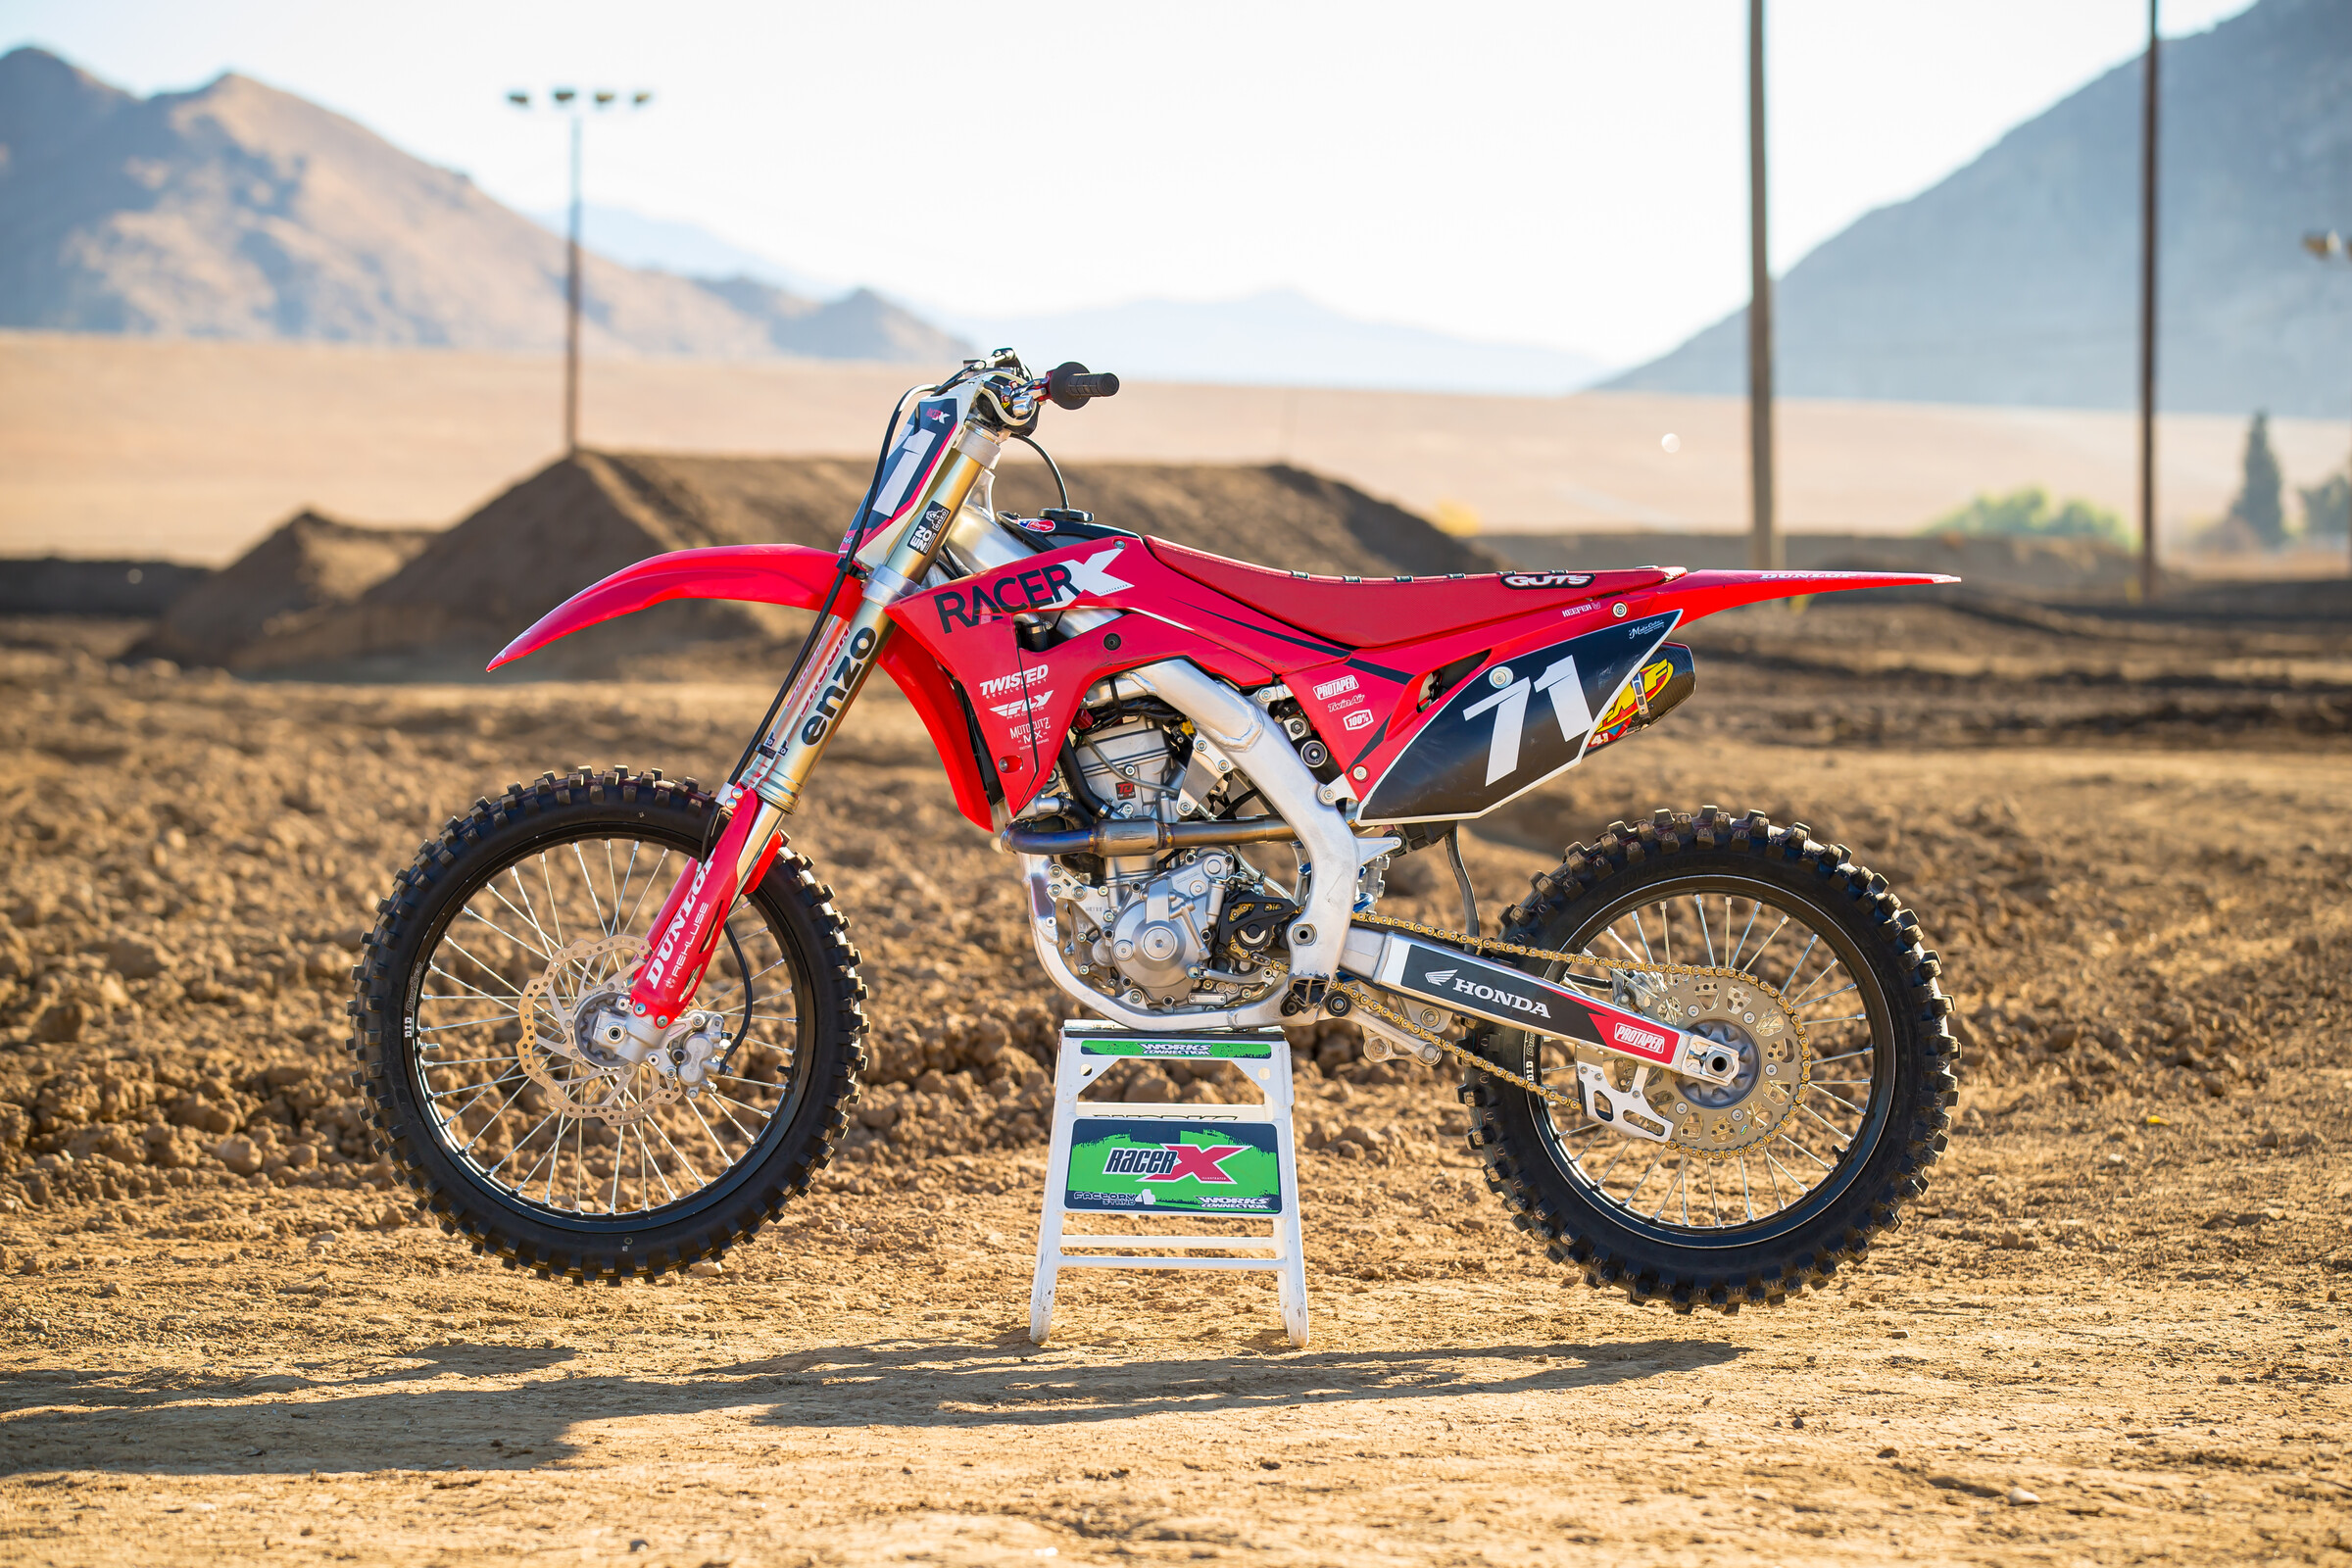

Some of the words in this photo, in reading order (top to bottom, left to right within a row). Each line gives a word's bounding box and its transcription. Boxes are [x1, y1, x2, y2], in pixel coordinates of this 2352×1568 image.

[1504, 574, 1592, 587] GUTS
[801, 625, 878, 747] enzo
[980, 663, 1049, 696] TWISTED
[1316, 675, 1356, 700] PROTAPER
[998, 689, 1054, 716] FLY
[1006, 706, 1045, 720] RACNG
[1348, 711, 1369, 727] 100%
[1462, 655, 1593, 787] 71
[671, 902, 710, 978] REKLUSE
[1452, 977, 1551, 1019] HONDA
[1137, 1043, 1213, 1052] WORKS
[1616, 1024, 1665, 1054] PROTAPER
[1196, 1196, 1272, 1204] WORKS
